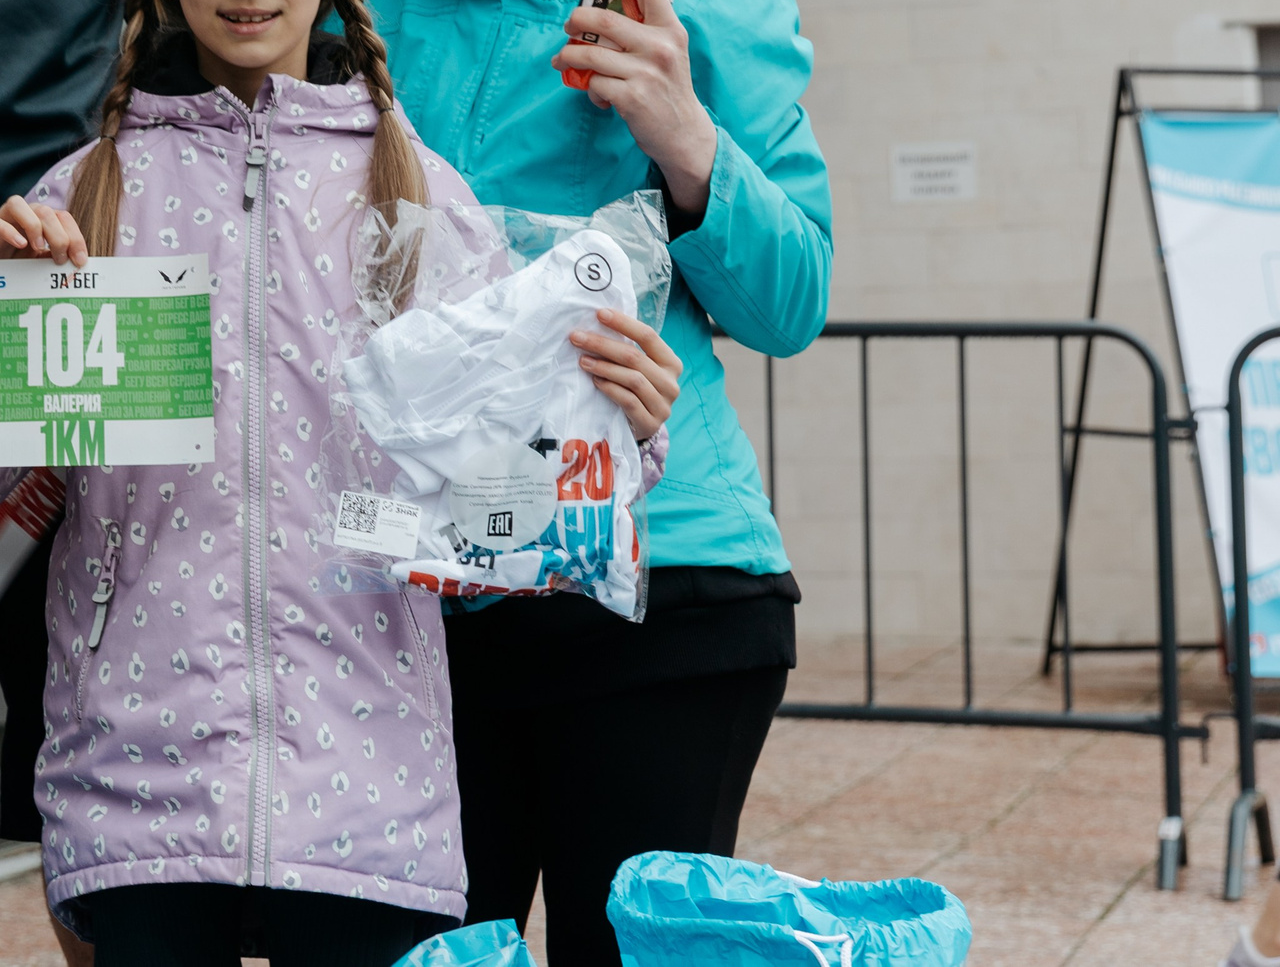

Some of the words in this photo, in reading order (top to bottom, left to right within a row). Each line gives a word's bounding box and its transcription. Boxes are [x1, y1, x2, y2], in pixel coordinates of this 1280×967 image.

[587, 263, 601, 281] S
[18, 301, 125, 388] 104
[43, 394, 102, 413] ВАЛЕРИЯ
[556, 438, 615, 502] 20
[488, 514, 512, 535] EAC
